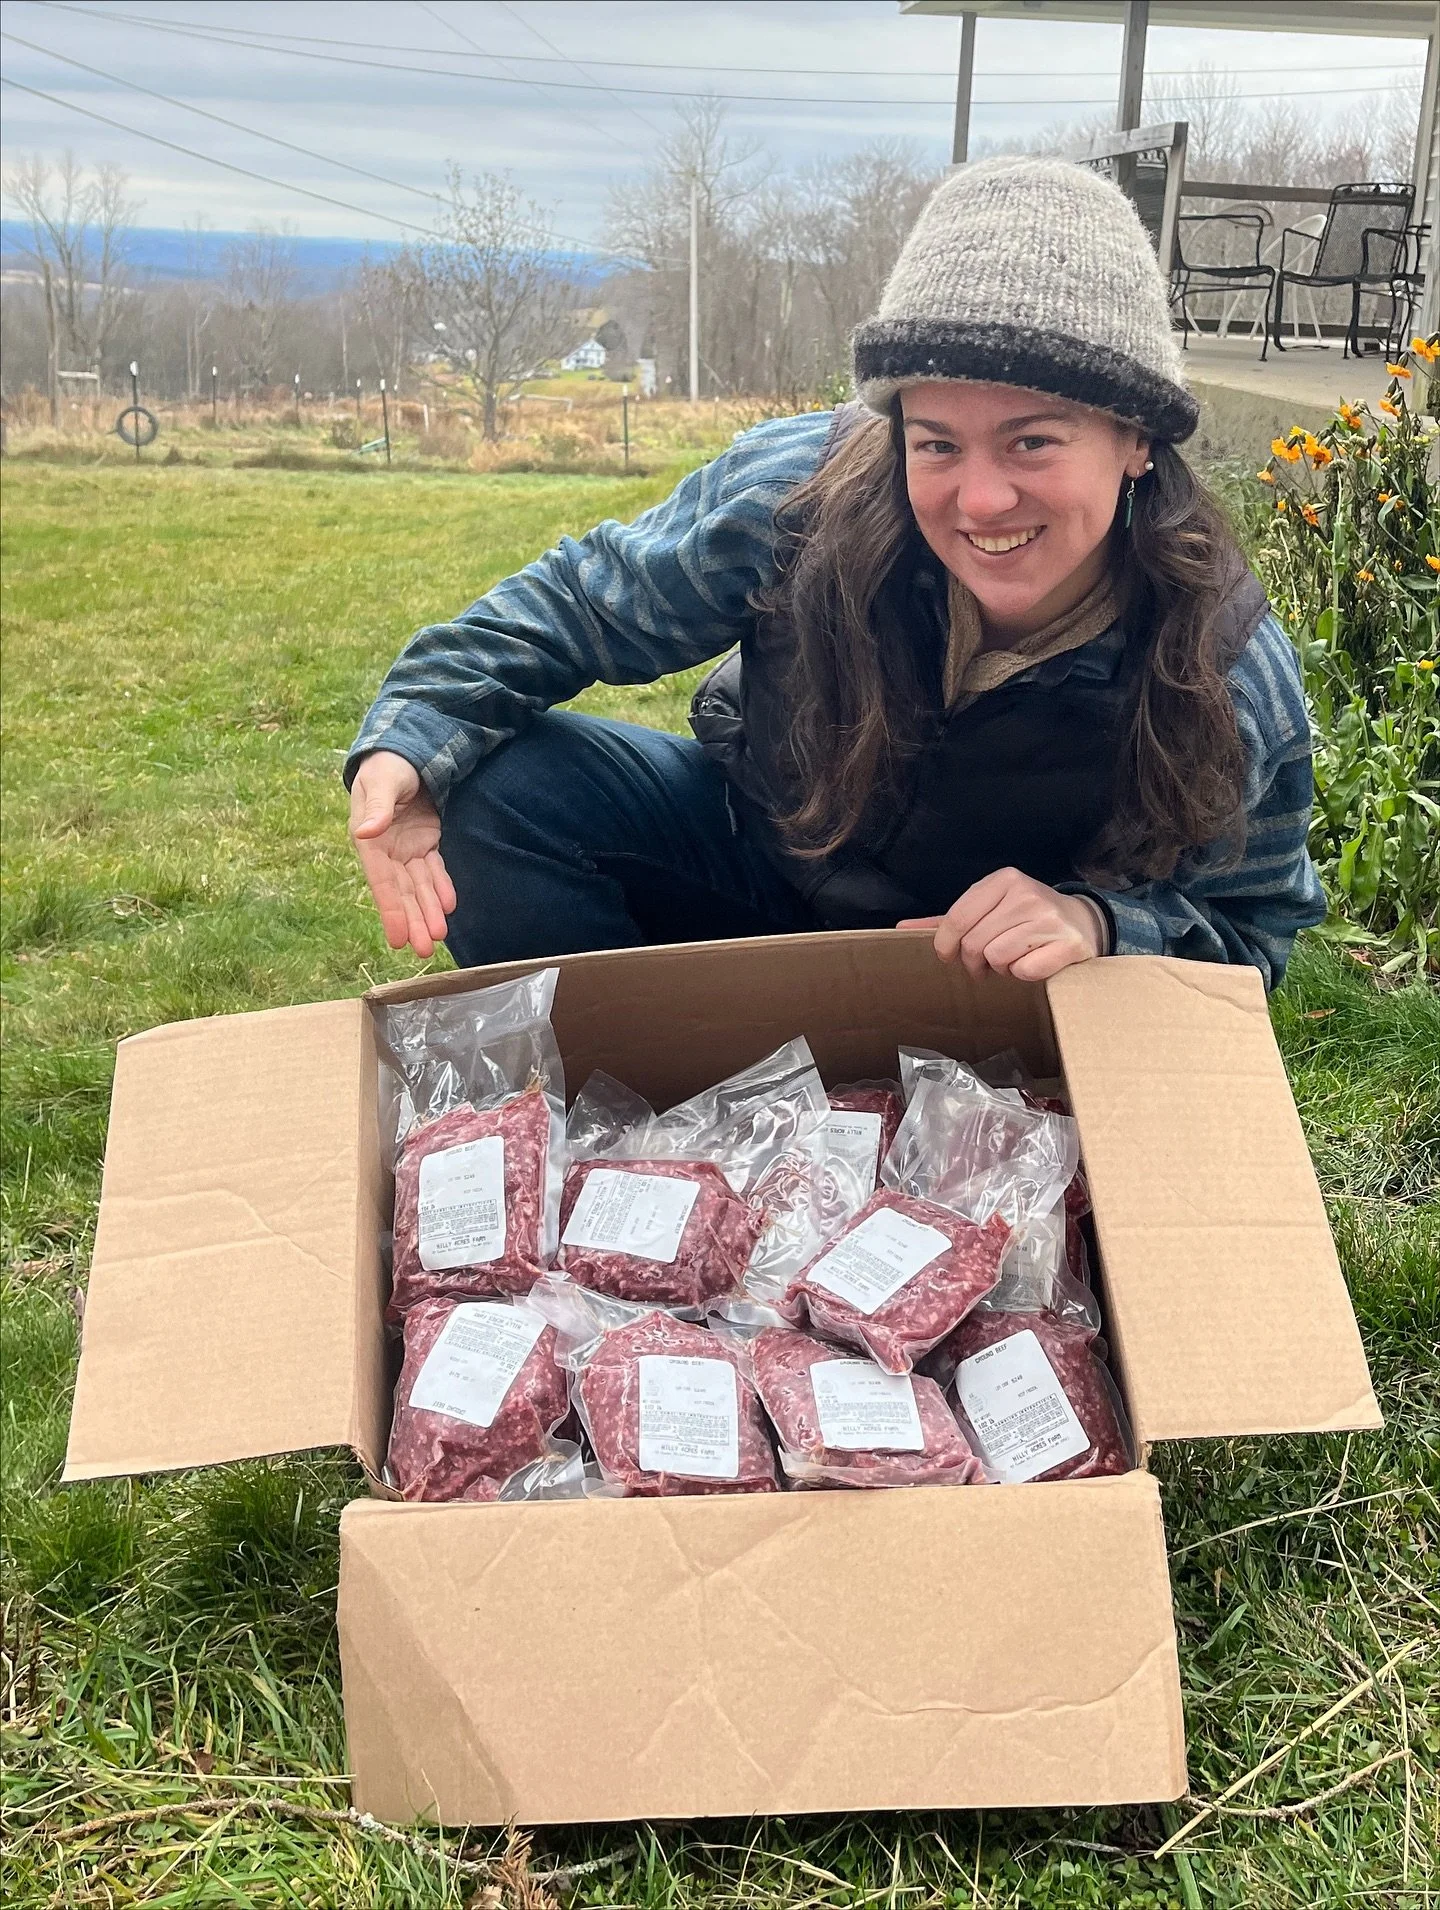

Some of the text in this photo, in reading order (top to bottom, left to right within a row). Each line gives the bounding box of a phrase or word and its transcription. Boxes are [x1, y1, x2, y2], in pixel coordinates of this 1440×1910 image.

[975, 1344, 1008, 1364] GROUND BEEF
[1030, 1441, 1047, 1452] ACRES
[1048, 1433, 1062, 1443] FARM
